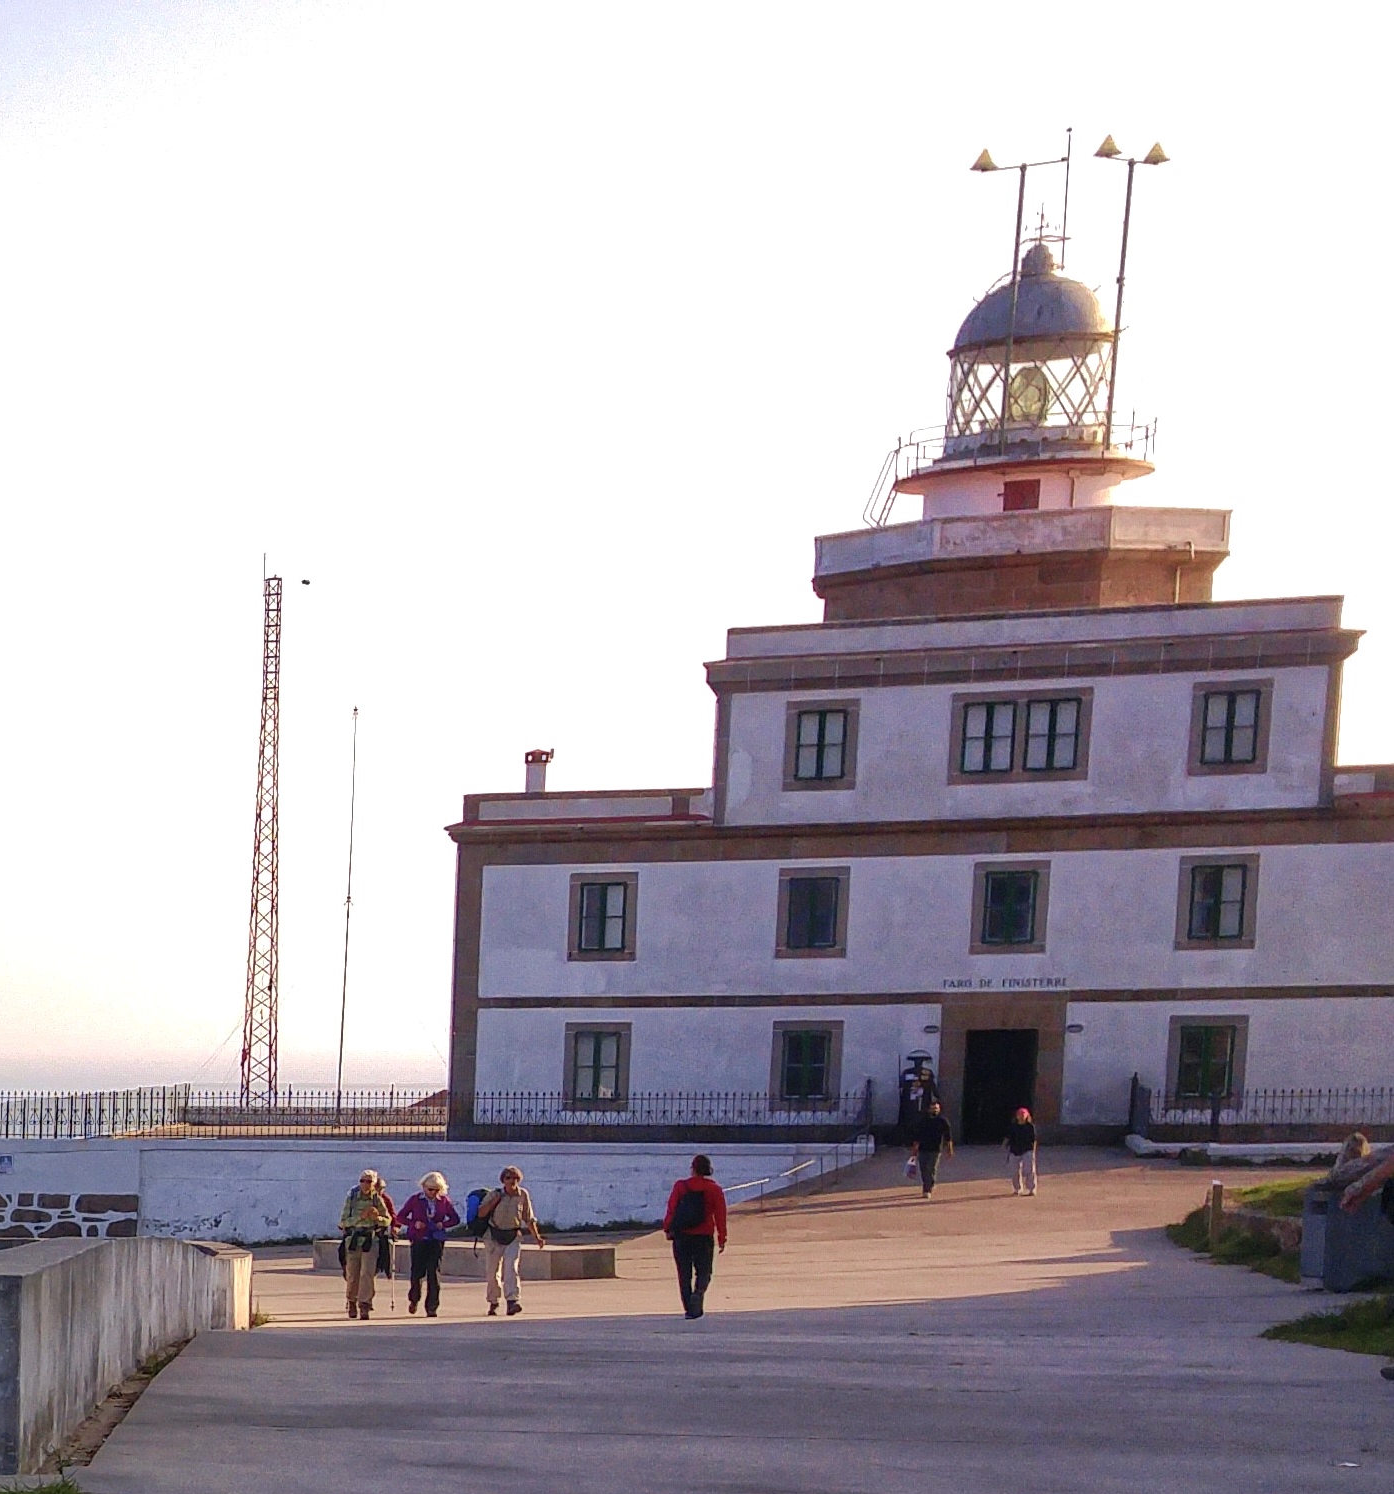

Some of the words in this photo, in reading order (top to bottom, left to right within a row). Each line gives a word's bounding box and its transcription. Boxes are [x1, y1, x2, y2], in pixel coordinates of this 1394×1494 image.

[943, 978, 972, 988] FARO
[979, 978, 993, 988] DE
[1002, 977, 1067, 988] FINISTERRE
